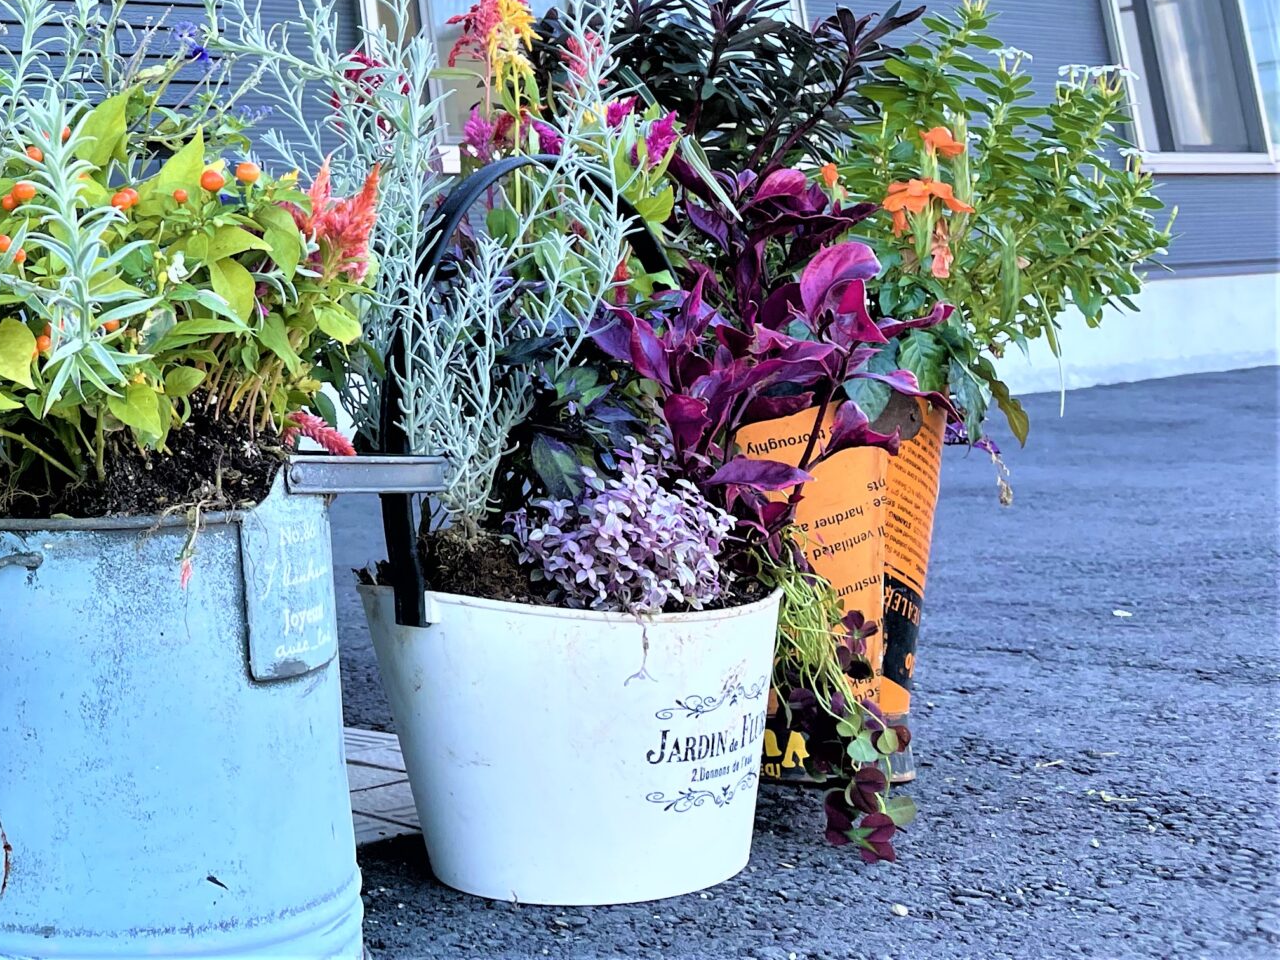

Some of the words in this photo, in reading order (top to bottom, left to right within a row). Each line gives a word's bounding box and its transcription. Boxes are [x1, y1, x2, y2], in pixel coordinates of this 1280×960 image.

[746, 428, 826, 456] toroughly
[814, 505, 864, 530] hardner
[646, 729, 728, 765] JARDIN
[729, 738, 738, 753] de
